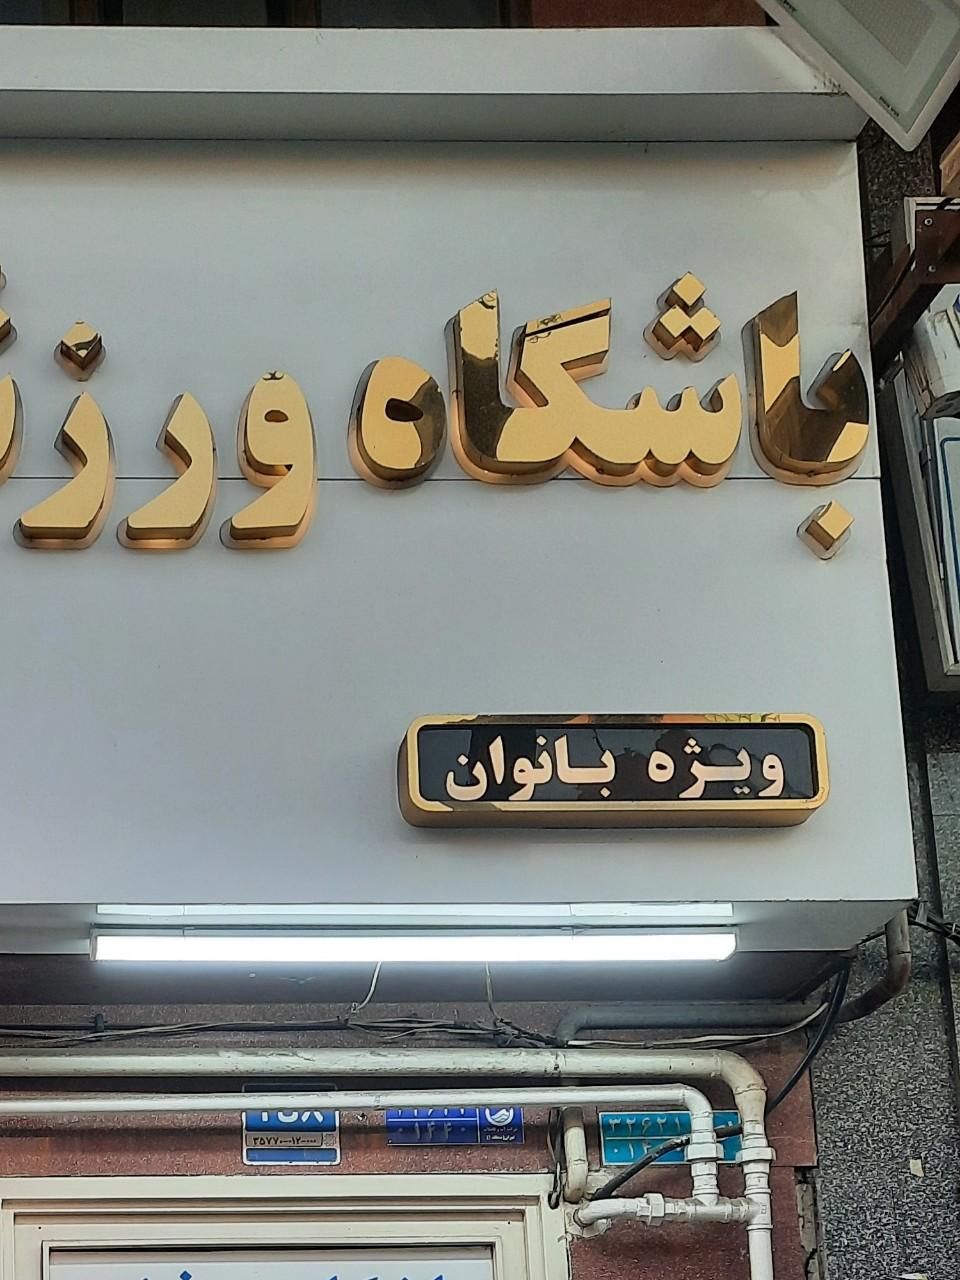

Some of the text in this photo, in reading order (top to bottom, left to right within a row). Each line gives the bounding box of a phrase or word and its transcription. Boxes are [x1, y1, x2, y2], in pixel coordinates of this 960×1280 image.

[351, 271, 871, 559] باشگاه
[445, 735, 786, 801] ویژه بانوان
